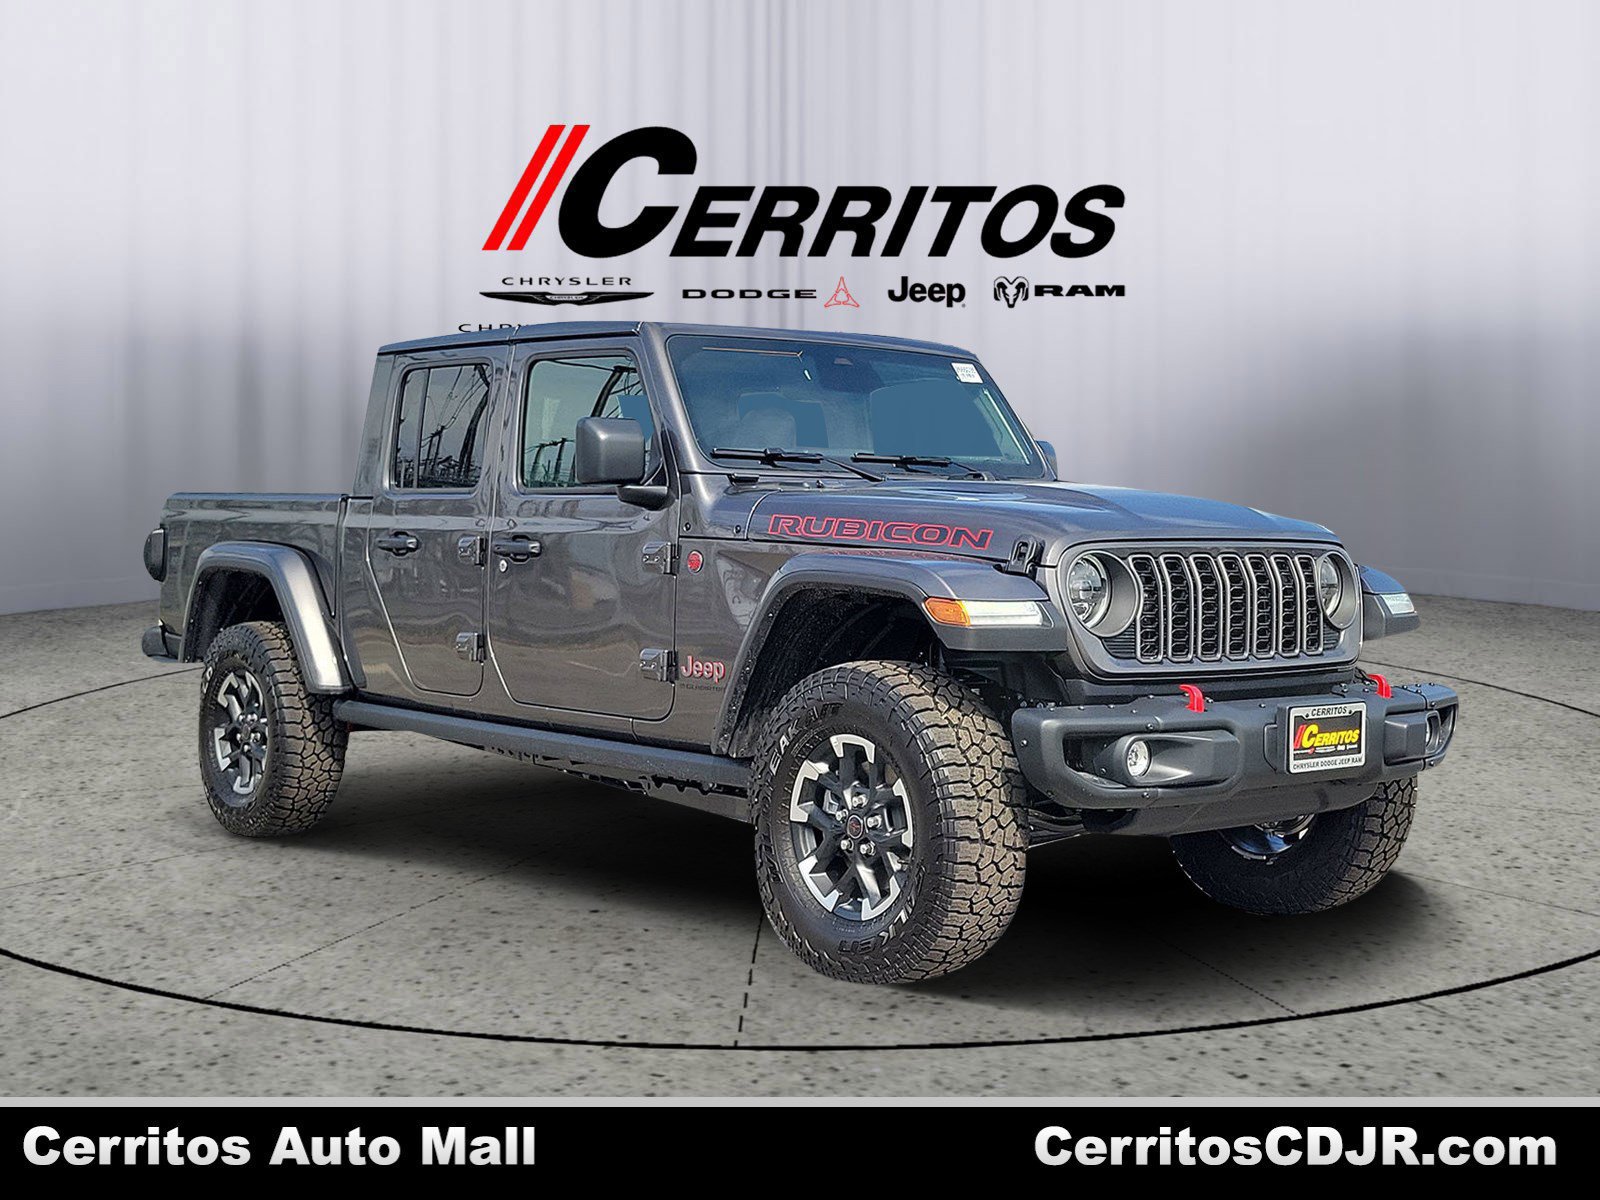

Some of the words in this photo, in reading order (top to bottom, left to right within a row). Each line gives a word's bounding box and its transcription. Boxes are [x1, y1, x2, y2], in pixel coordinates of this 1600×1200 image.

[558, 125, 1125, 258] CERRITOS
[501, 276, 632, 286] CHRYSLER
[682, 288, 817, 300] DODGE
[887, 275, 966, 308] Jeep
[1034, 284, 1126, 297] RAM
[768, 514, 994, 550] RUBICON
[680, 655, 726, 685] Jeep
[1311, 706, 1348, 717] CERRITOS
[1302, 724, 1360, 748] CERRITOS
[1292, 761, 1320, 770] CHRYSLER
[1320, 759, 1338, 767] DODGE
[1338, 757, 1350, 765] JEEP
